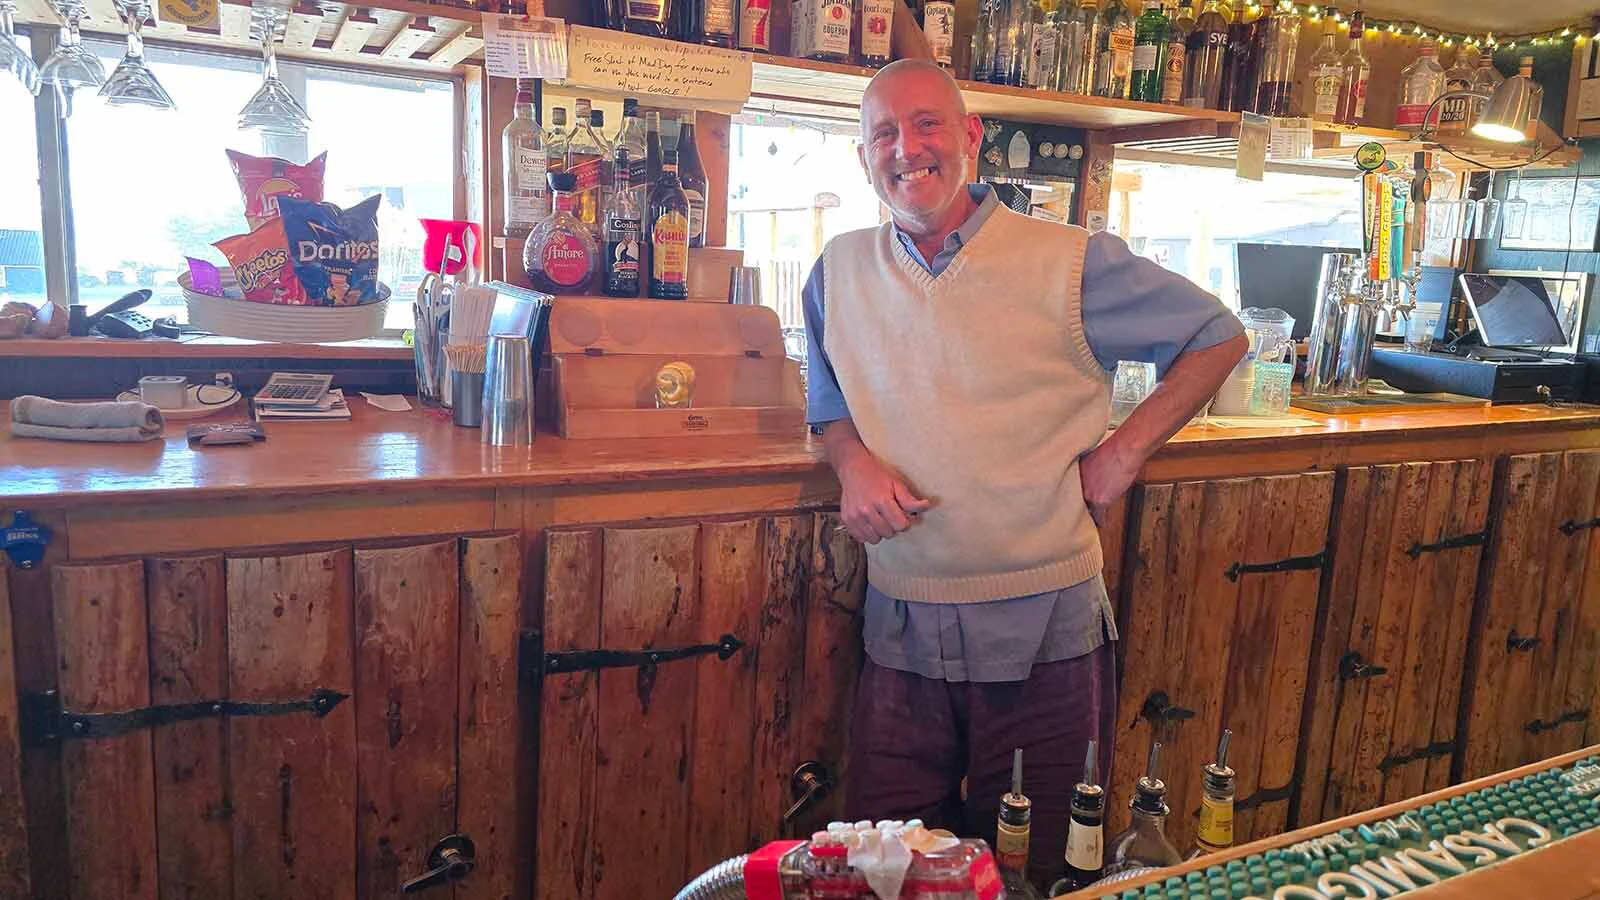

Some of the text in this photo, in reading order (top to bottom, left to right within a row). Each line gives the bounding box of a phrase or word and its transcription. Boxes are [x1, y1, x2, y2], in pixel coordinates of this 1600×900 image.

[822, 25, 848, 37] BOURBON
[583, 52, 602, 64] Free
[604, 52, 624, 64] Shot
[627, 55, 636, 65] of
[674, 58, 688, 69] for
[691, 65, 714, 75] anyone
[716, 65, 730, 75] who
[626, 68, 639, 78] this
[643, 72, 661, 81] word
[682, 76, 713, 87] sentence
[647, 84, 680, 96] GOOGLE
[1441, 98, 1466, 113] MD
[299, 240, 378, 262] Doritos
[548, 245, 584, 261] Amore
[235, 248, 288, 292] Cheetos
[1240, 817, 1551, 900] CASAMIGO
